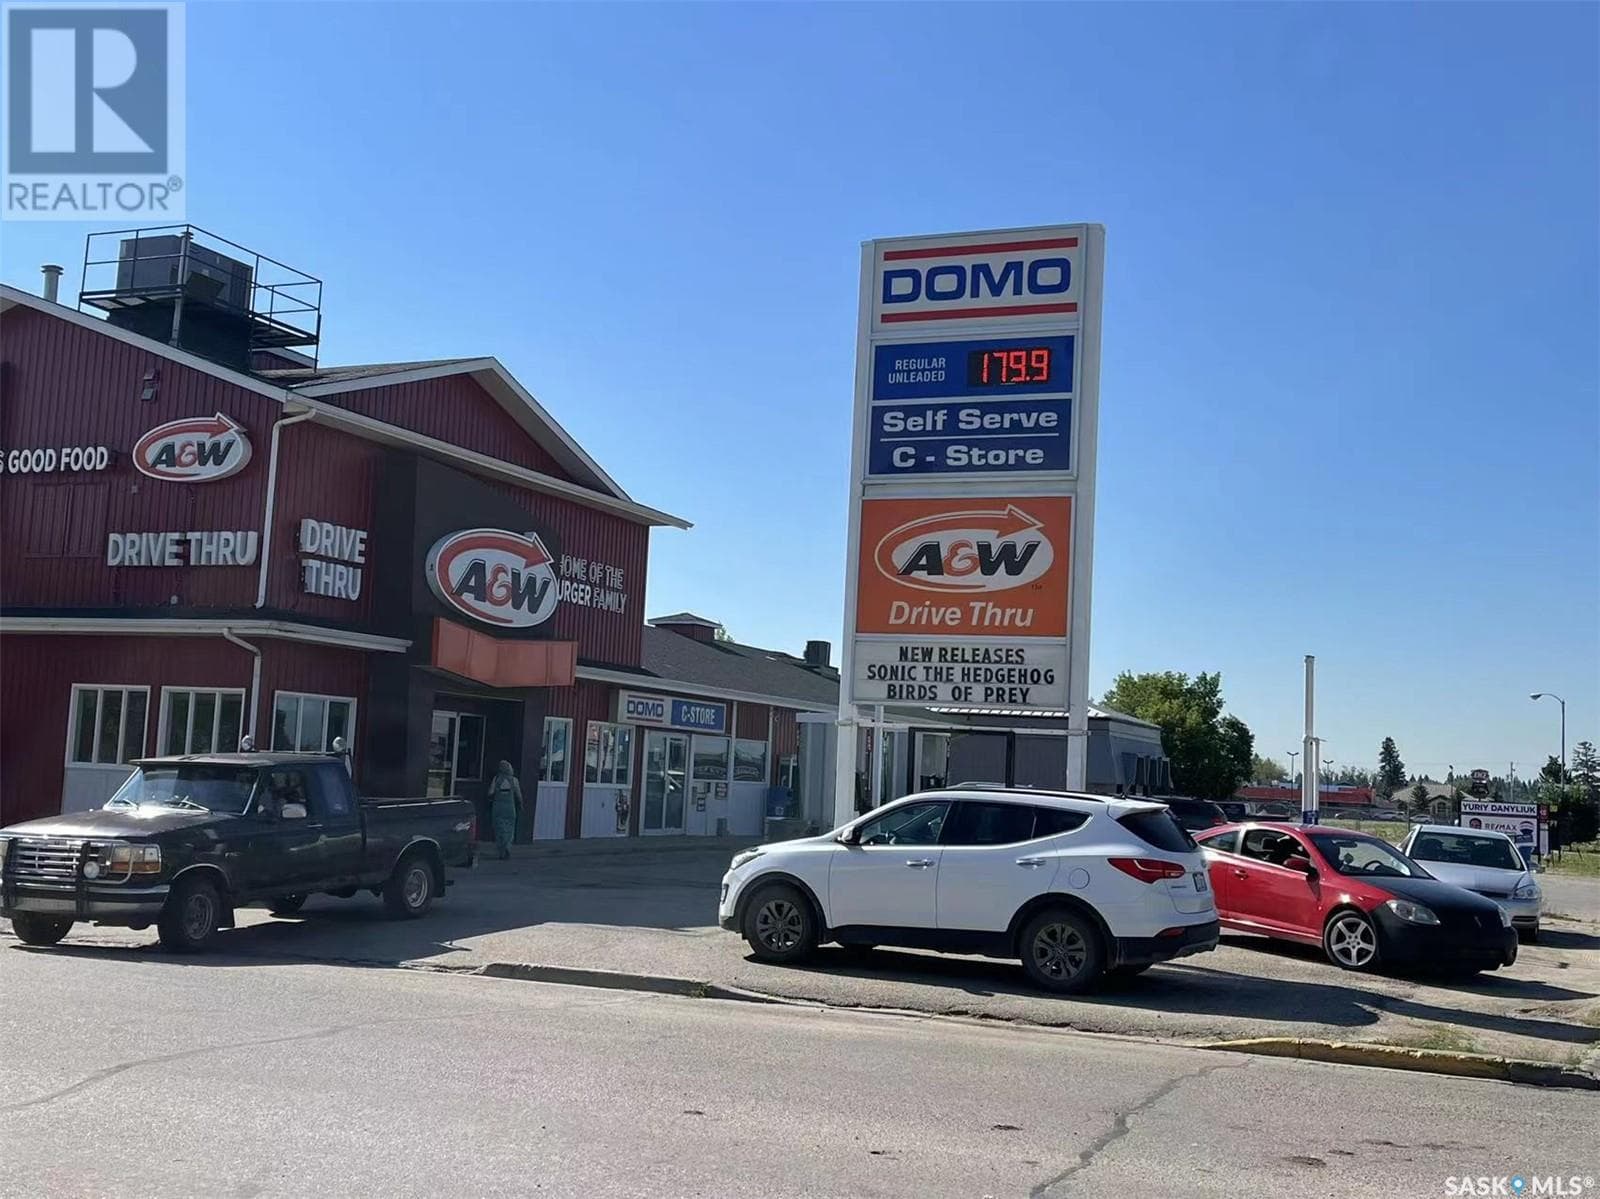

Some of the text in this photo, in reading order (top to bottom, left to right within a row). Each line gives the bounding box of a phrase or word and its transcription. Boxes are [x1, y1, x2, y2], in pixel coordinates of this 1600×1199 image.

[882, 258, 1071, 304] DOMO
[888, 371, 945, 384] UNLEADED
[895, 358, 946, 370] REGULAR
[981, 350, 1049, 383] 179.9
[883, 409, 1059, 432] Self Serve
[8, 448, 56, 474] GOOD
[60, 446, 108, 471] FOOD
[150, 439, 235, 468] A&W
[892, 447, 916, 468] C
[945, 446, 1044, 466] Store
[107, 532, 257, 566] DRIVE THRU
[300, 518, 367, 563] DRIVE
[897, 540, 1041, 577] A&W
[302, 559, 362, 600] THRU
[453, 559, 550, 614] A&W
[589, 561, 603, 584] OF
[605, 565, 624, 589] THE
[556, 578, 627, 614] URGER FAMILY
[888, 600, 1034, 627] Drive Thru
[899, 646, 1025, 664] NEW RELEASES
[867, 664, 1055, 684] SONIC THE HEDGEHOG
[887, 684, 1031, 704] BIRDS OF PREY
[626, 700, 665, 718] DOMO
[681, 705, 716, 725] C-STORE
[1462, 803, 1536, 814] YURIY DANYLIUK
[1485, 822, 1518, 832] RE/MAX
